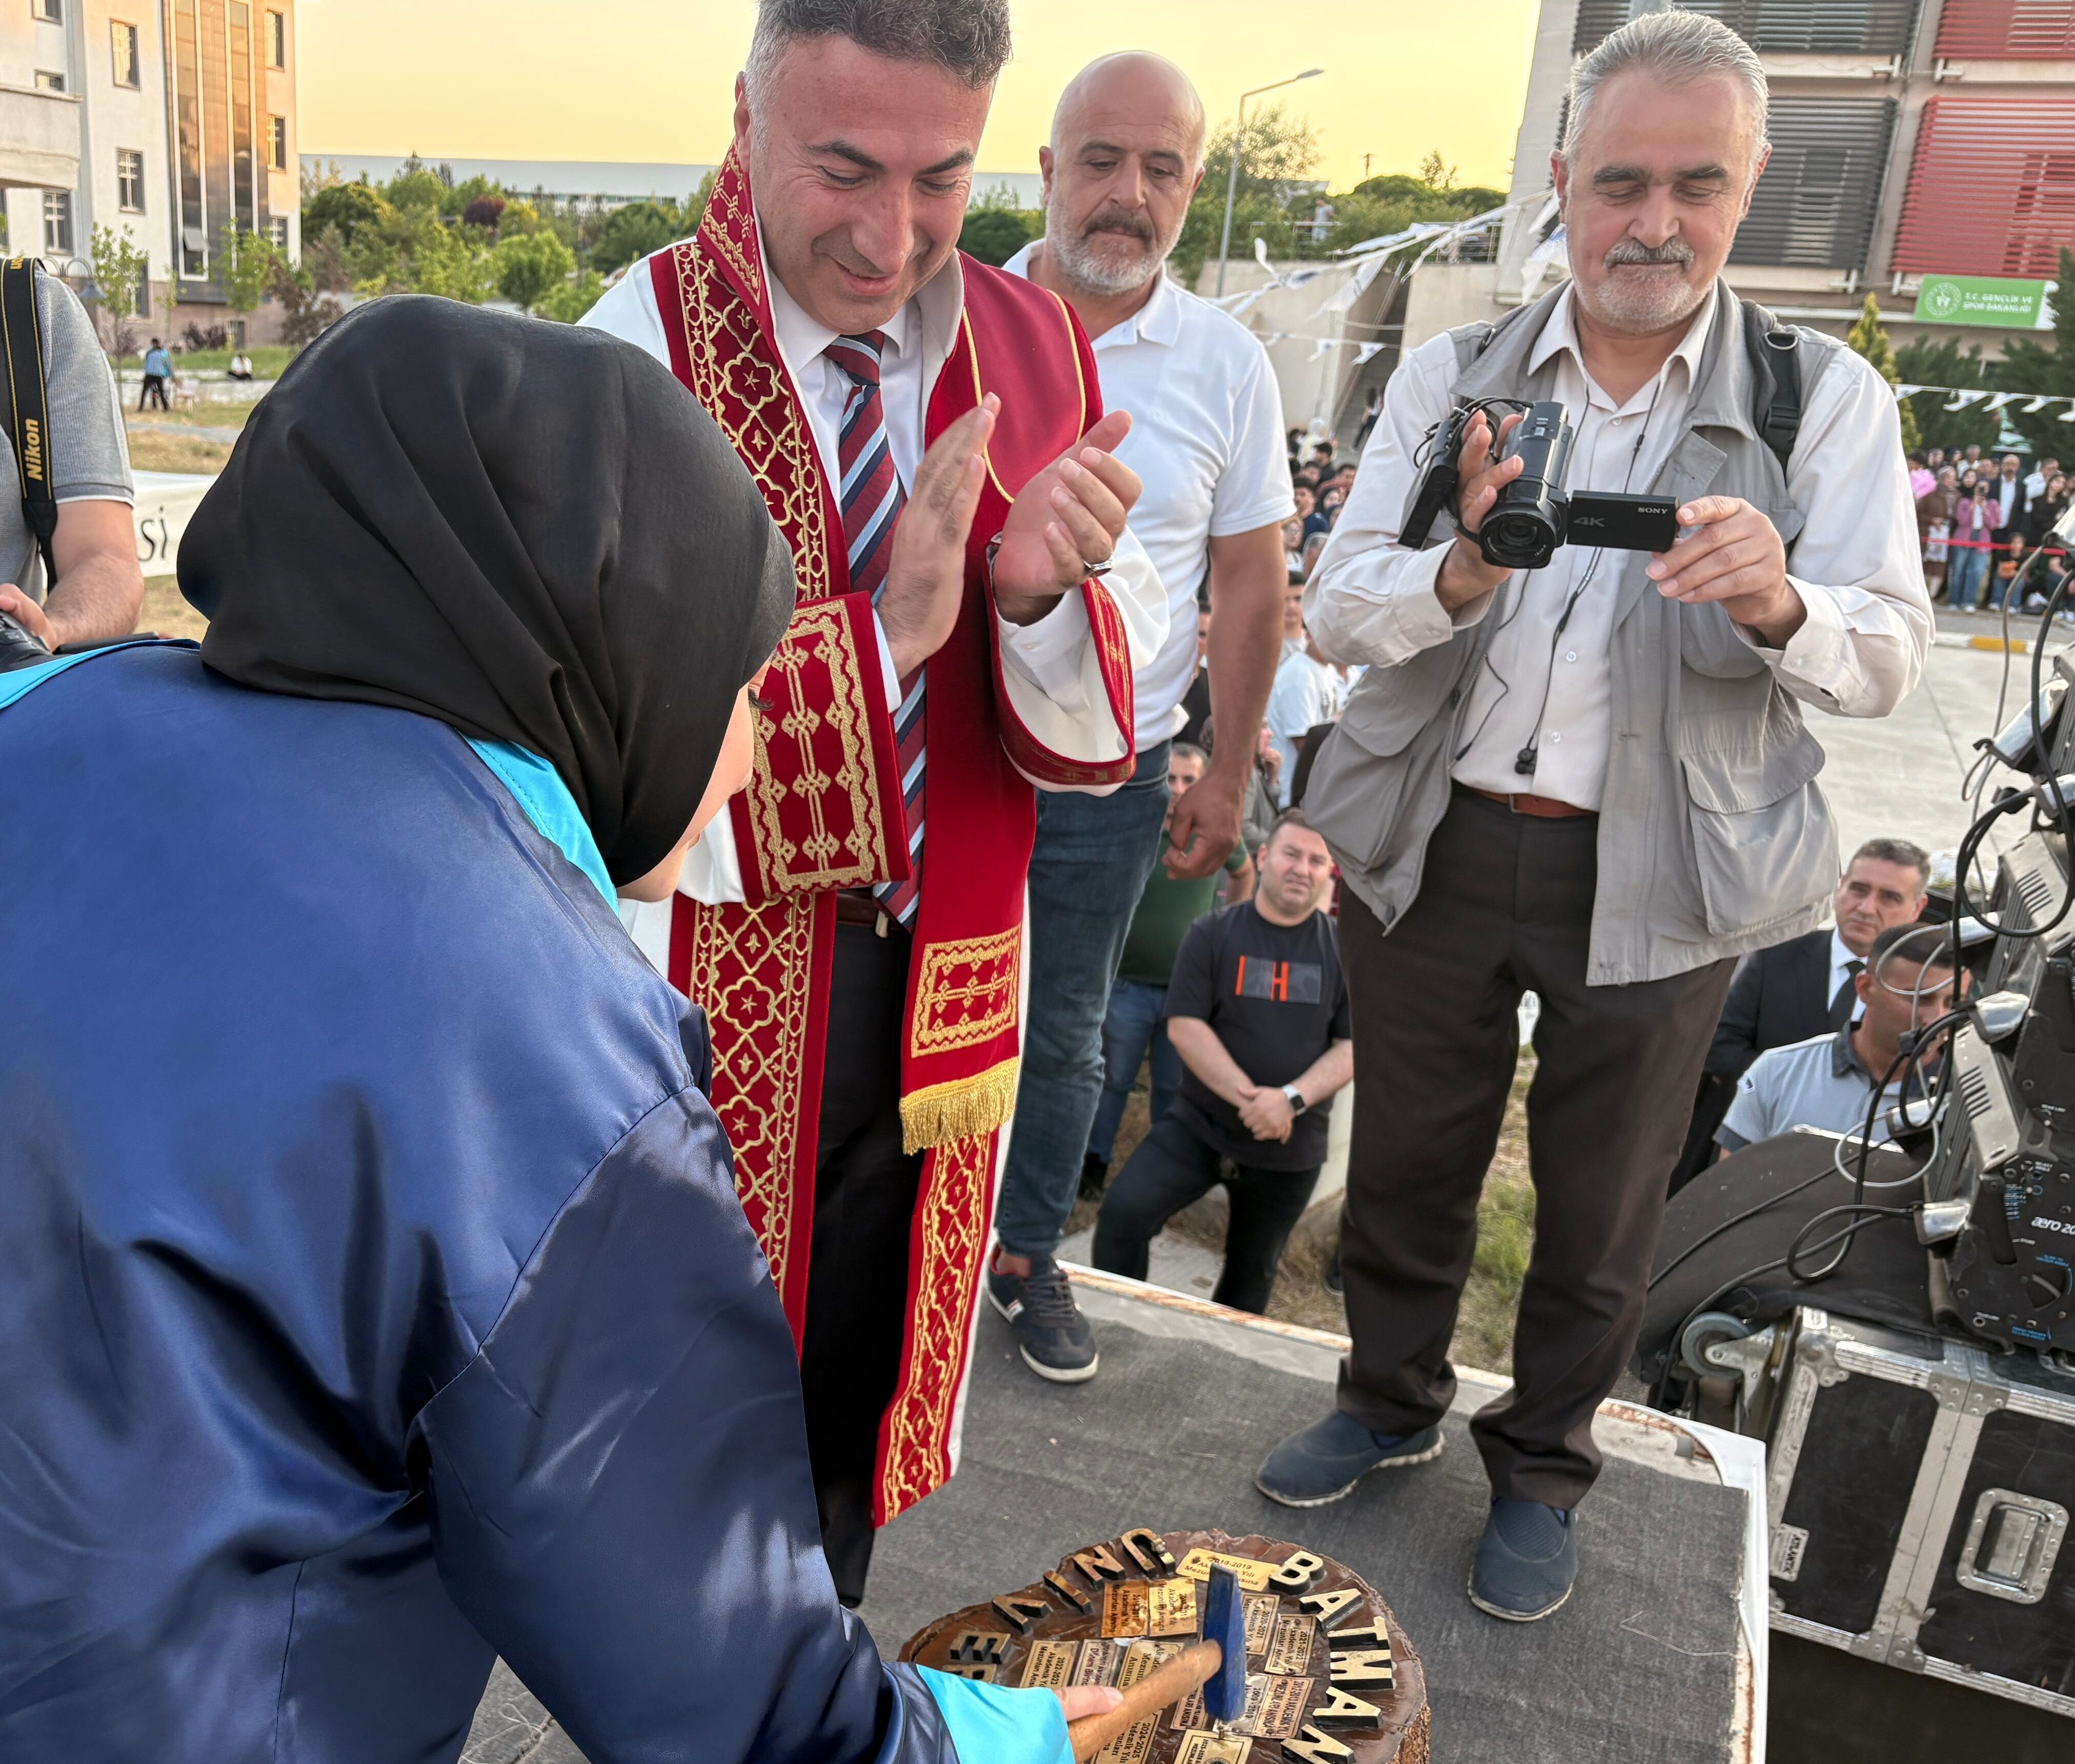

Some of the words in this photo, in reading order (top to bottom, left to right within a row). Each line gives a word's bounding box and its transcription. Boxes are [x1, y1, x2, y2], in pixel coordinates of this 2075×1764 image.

[26, 418, 43, 481] Nikon
[1573, 516, 1606, 528] 4K
[1638, 506, 1668, 515] SONY
[2031, 1216, 2061, 1231] aero
[1296, 1630, 1308, 1660] 2021-2022
[1042, 1651, 1056, 1680] Akademik
[1050, 1657, 1065, 1685] 2022-2023
[1132, 1722, 1151, 1758] 2024-2025
[1119, 1751, 1131, 1763] Yılı
